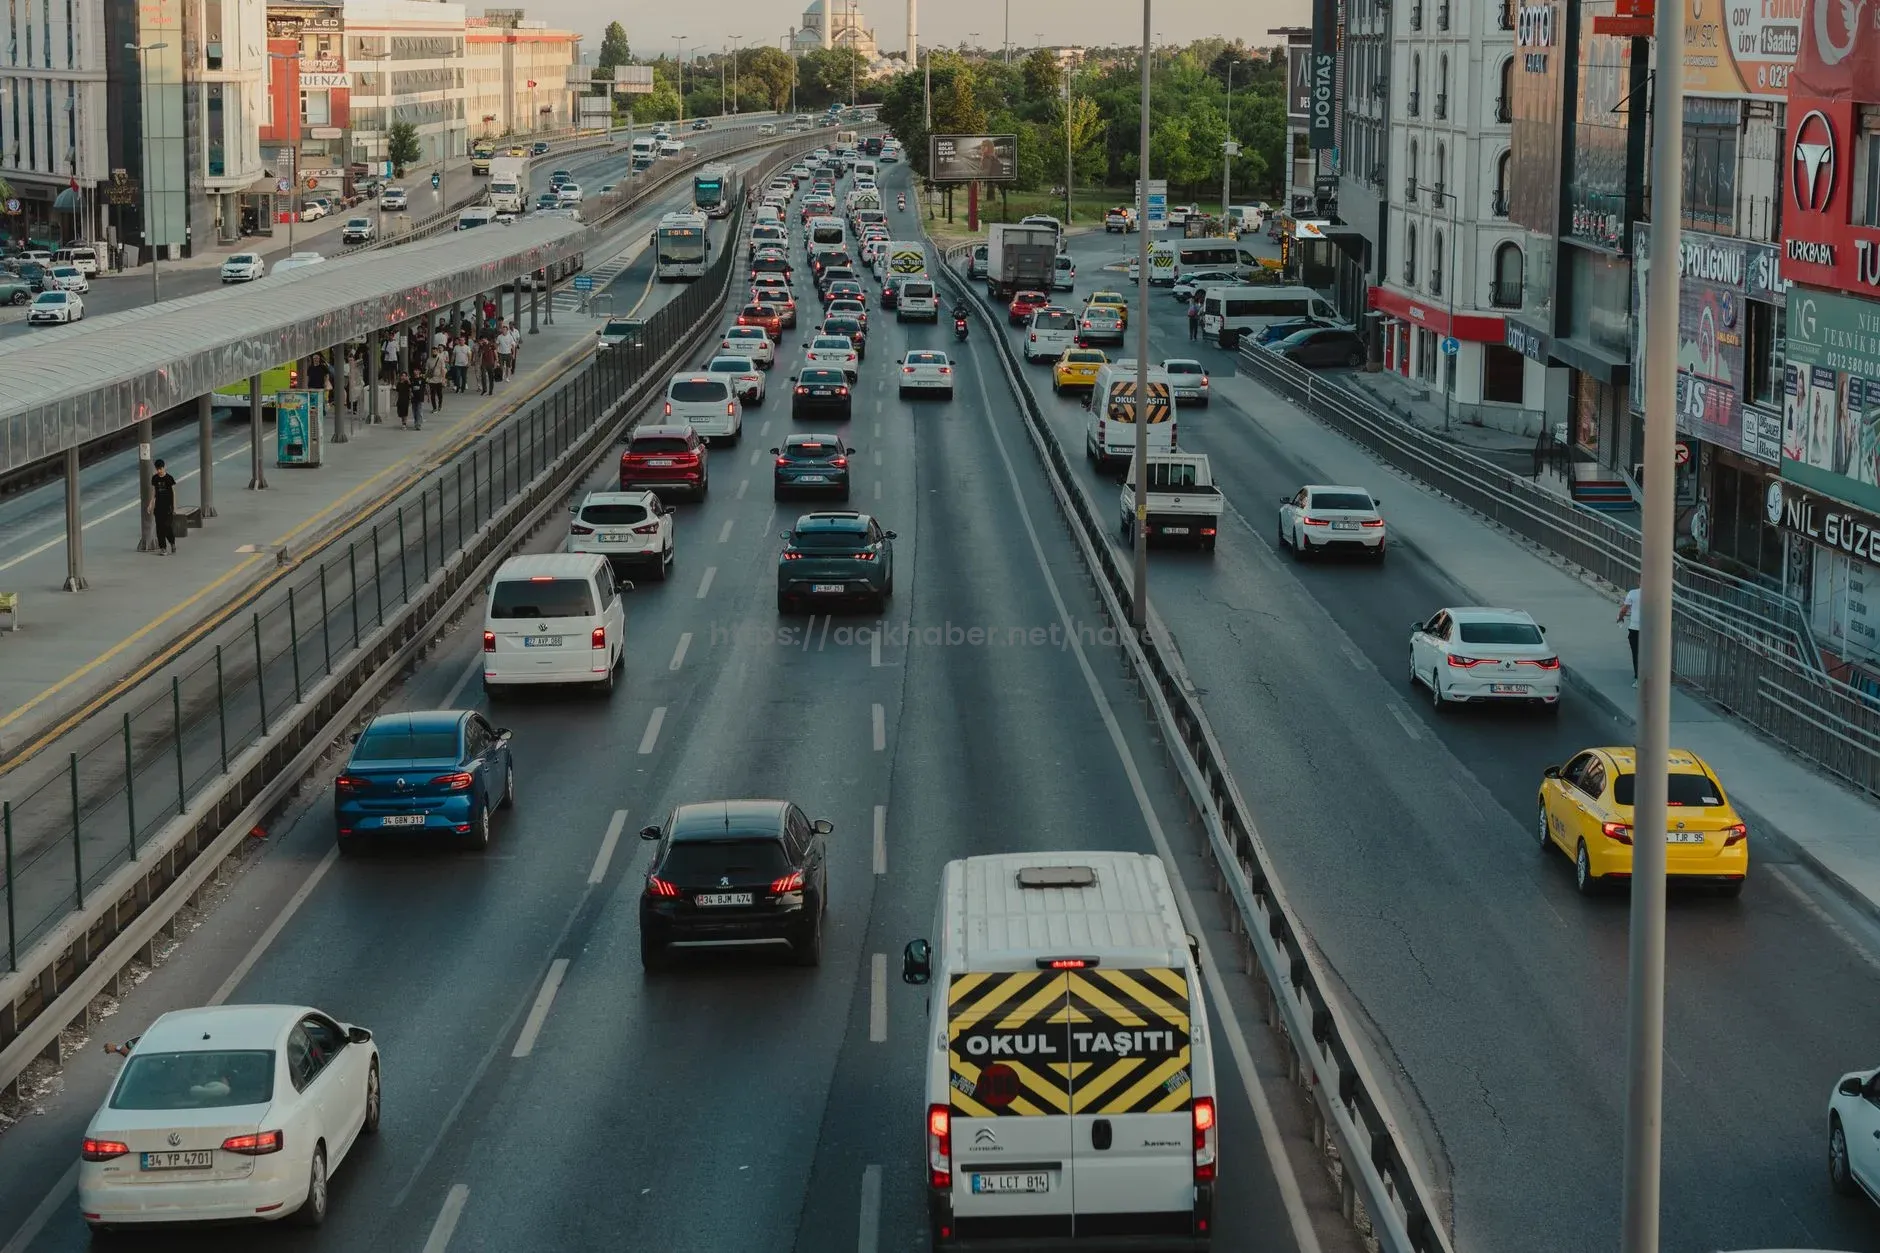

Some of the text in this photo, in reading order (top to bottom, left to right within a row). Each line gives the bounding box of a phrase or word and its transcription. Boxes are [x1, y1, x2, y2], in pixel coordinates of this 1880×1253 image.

[314, 19, 339, 27] LED
[1732, 8, 1751, 27] ODY
[1313, 53, 1335, 129] DOĞTAŞ
[1686, 246, 1740, 285] POLİGONU
[1823, 327, 1866, 353] TEKNİK
[1827, 351, 1846, 369] 0212
[1847, 356, 1862, 373] 580
[1759, 436, 1780, 461] Blaser
[1787, 495, 1819, 538] NİL
[383, 816, 393, 825] 34
[411, 814, 424, 823] 313
[703, 896, 713, 905] 34
[736, 893, 751, 903] 474
[966, 1031, 1173, 1056] OKUL TAŞITI
[149, 1152, 209, 1167] 34 YP 4701
[981, 1175, 1046, 1189] 34 LCT 814
